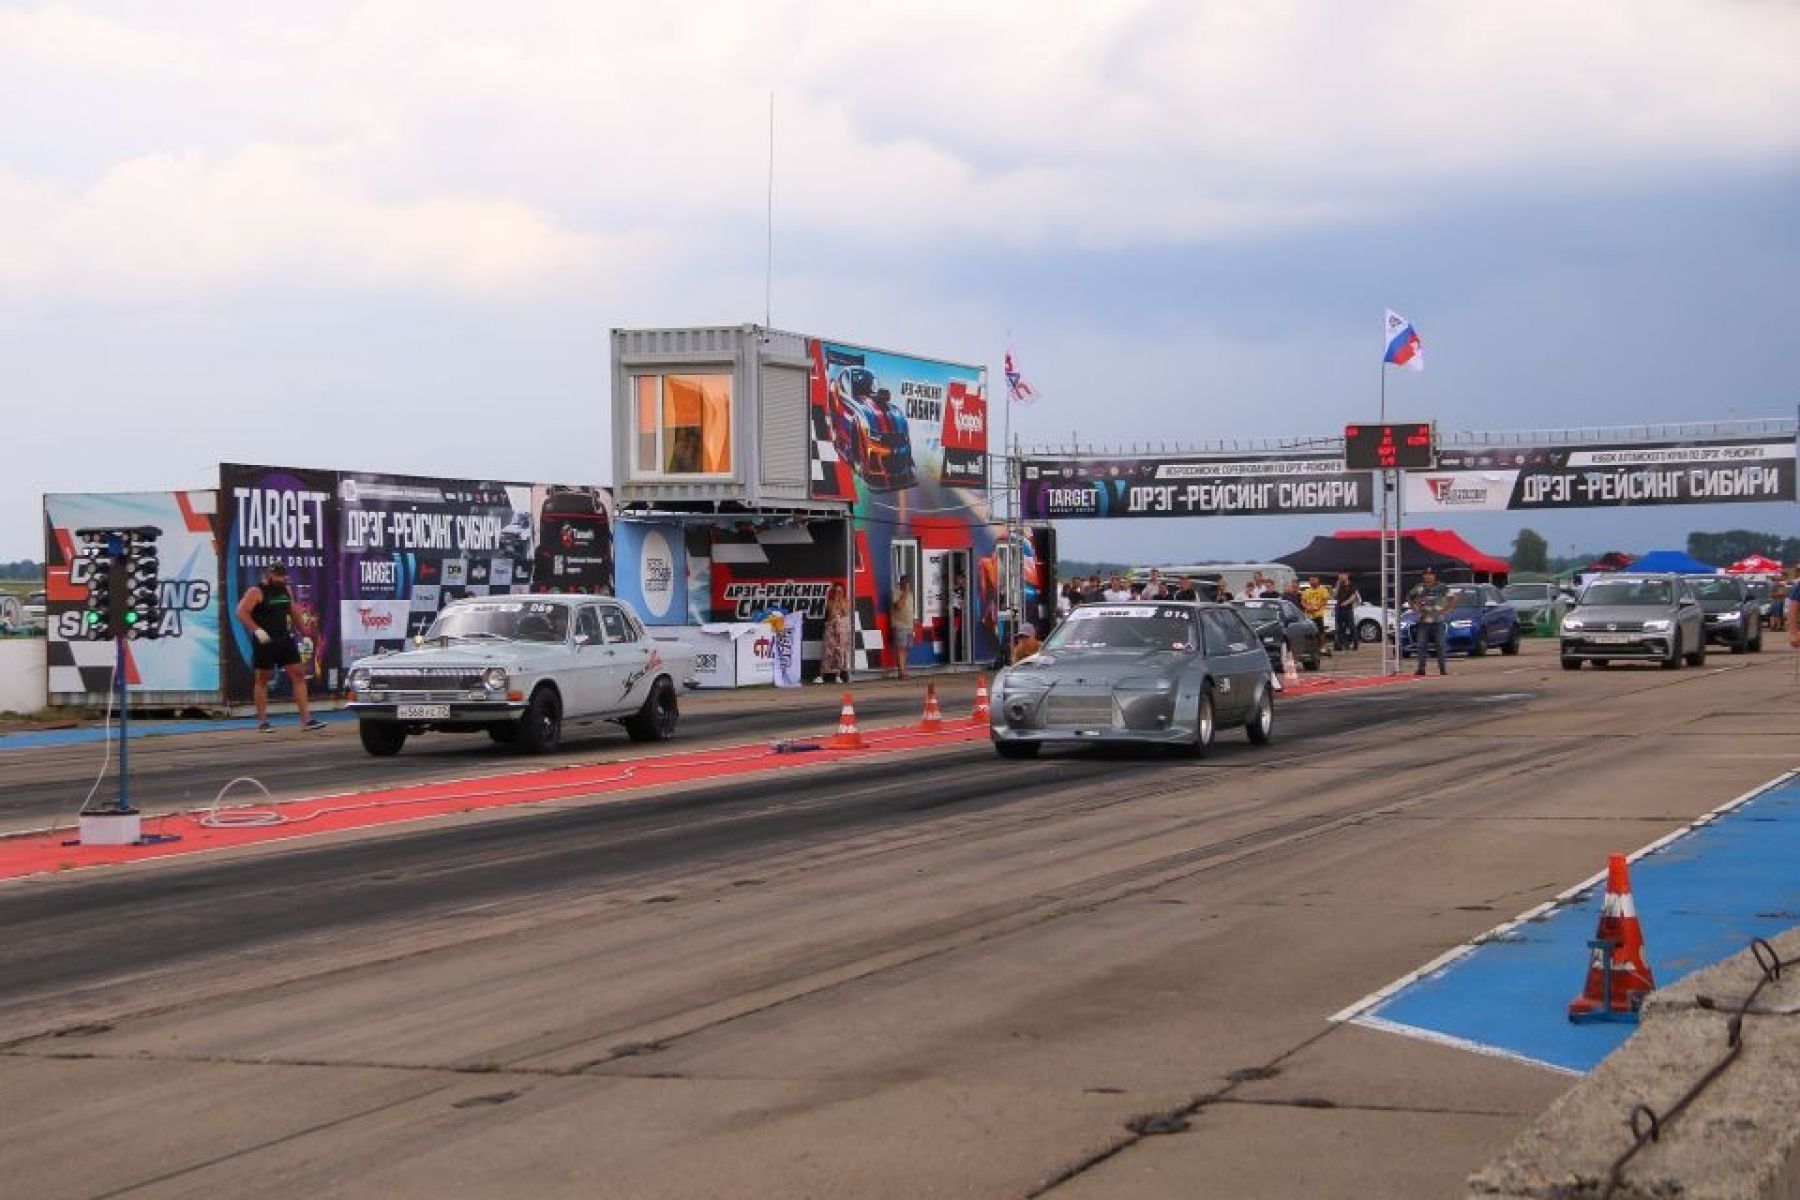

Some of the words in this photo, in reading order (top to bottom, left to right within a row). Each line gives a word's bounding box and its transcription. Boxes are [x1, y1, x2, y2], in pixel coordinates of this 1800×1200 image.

[1048, 488, 1098, 507] TARGET
[1128, 480, 1272, 511] ДРЭГ-РЕЙСИНГ
[1278, 481, 1358, 509] СИБИРИ
[1523, 469, 1684, 502] ДРЭГ-РЕЙСИНГ
[1690, 467, 1778, 496] СИБИРИ
[234, 487, 330, 549] TARGET
[346, 506, 454, 549] ДРЭГ-РЕЙСИНГ
[457, 515, 502, 550] СИБИРИ
[288, 556, 324, 568] DRINK
[360, 561, 396, 584] TARGET
